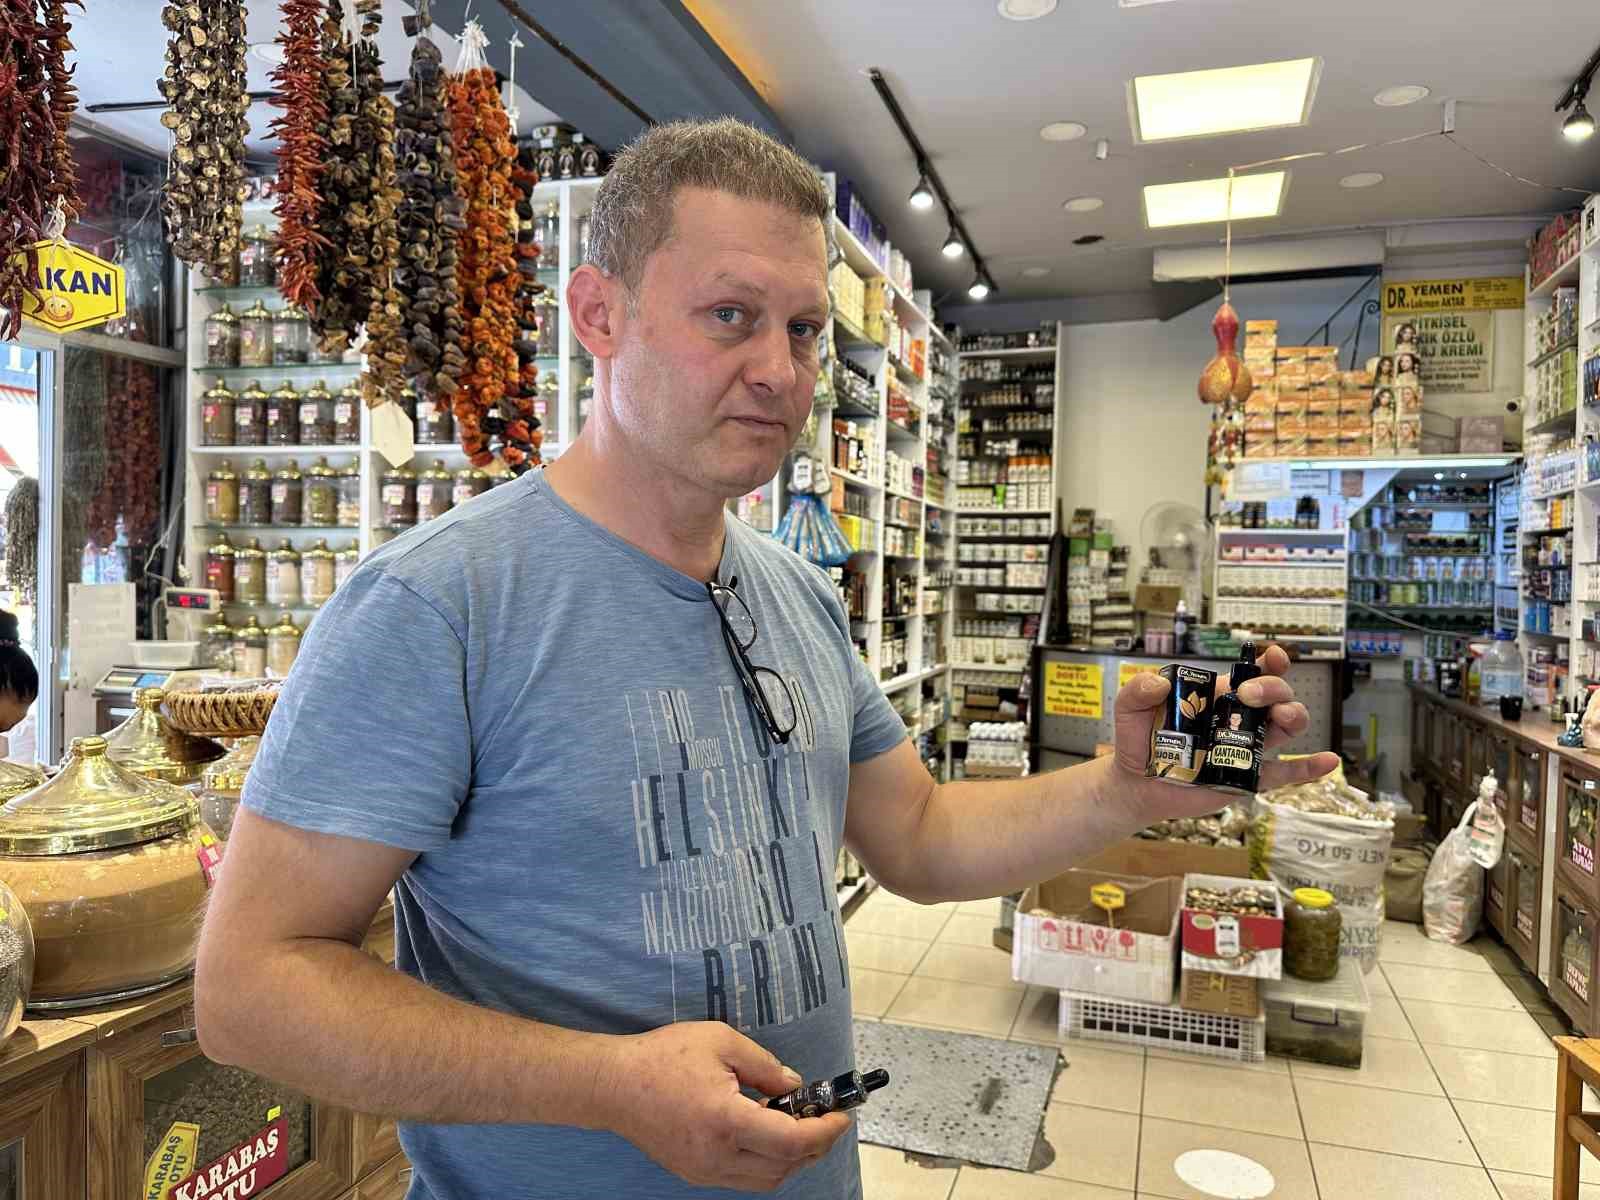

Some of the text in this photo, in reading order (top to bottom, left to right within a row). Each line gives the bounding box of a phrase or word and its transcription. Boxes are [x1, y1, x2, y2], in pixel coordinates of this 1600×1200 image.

[1387, 287, 1409, 309] DR.
[1411, 283, 1463, 297] YEMEN
[1332, 845, 1352, 861] 50
[169, 1155, 187, 1183] OTU
[175, 1128, 279, 1200] KARABAŞ
